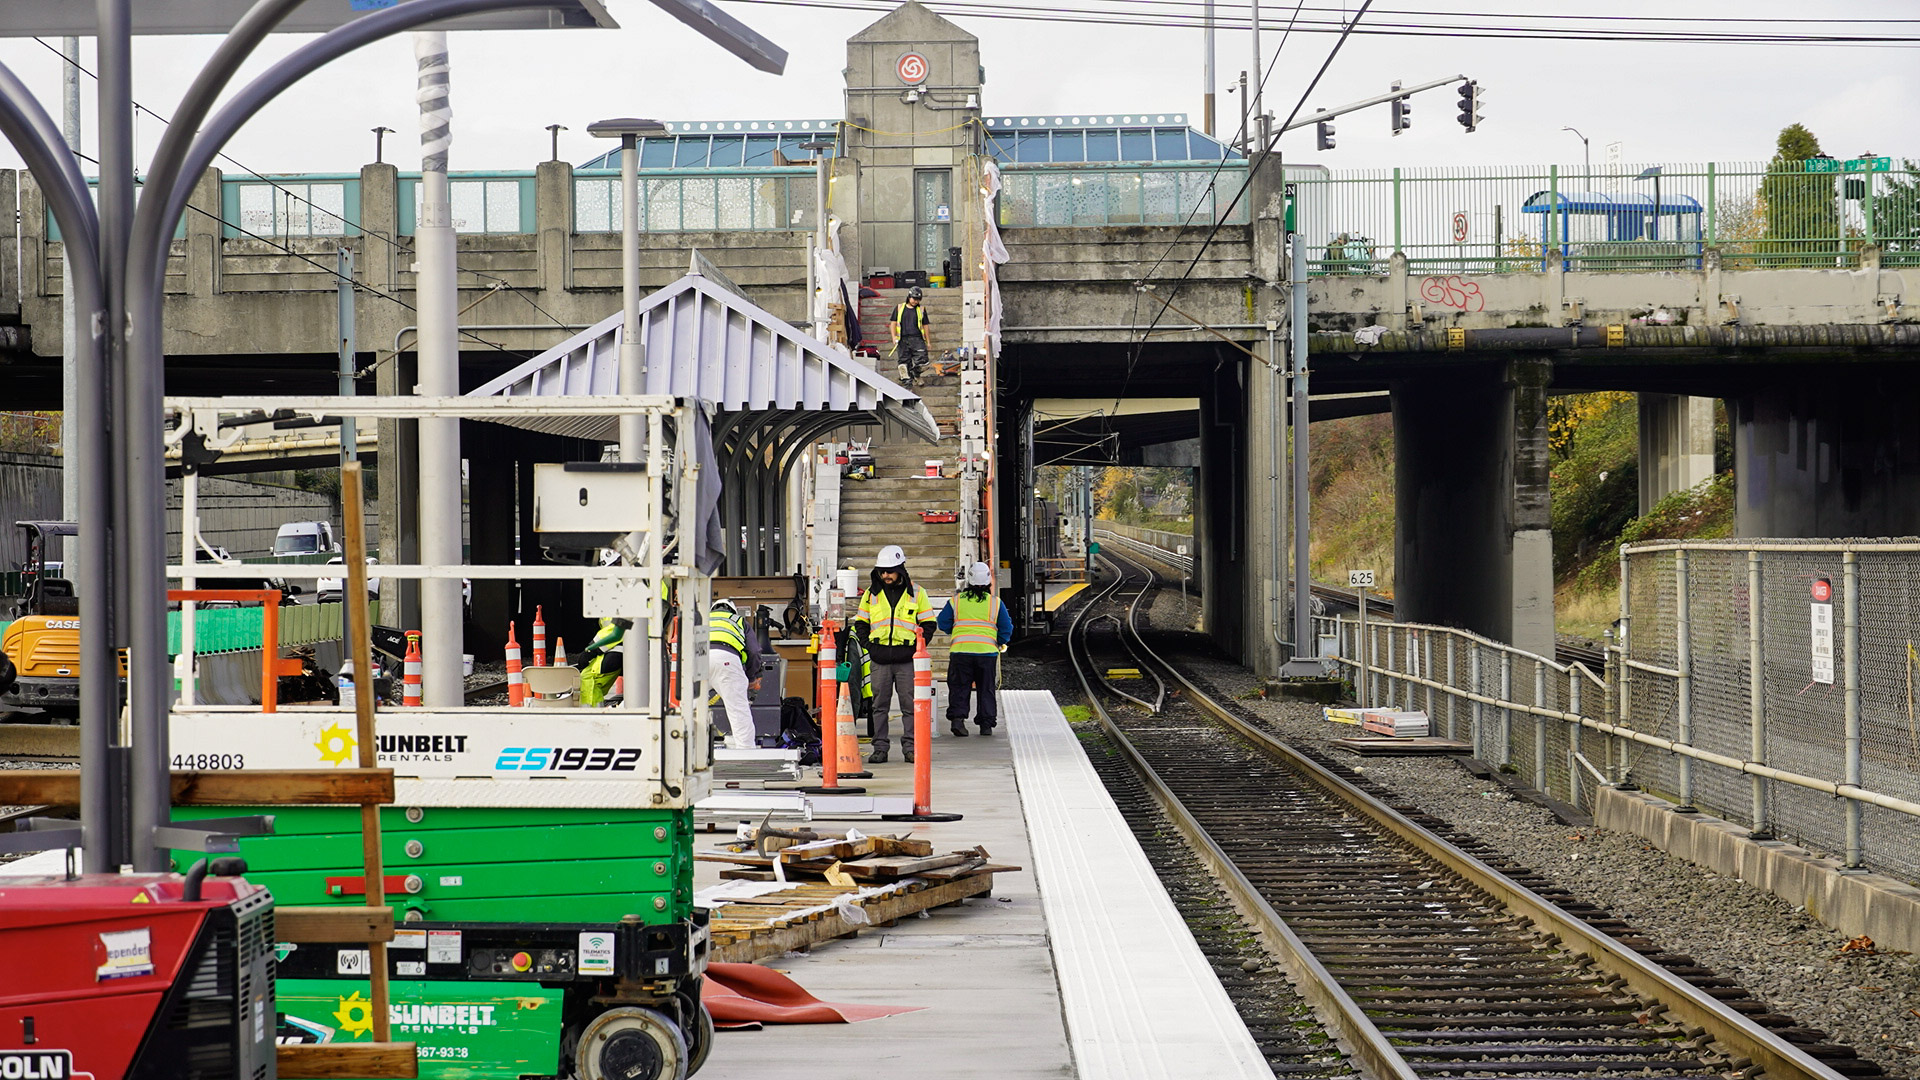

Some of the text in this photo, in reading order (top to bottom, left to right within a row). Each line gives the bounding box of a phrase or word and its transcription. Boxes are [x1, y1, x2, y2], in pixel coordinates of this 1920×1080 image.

[1351, 572, 1373, 584] 6.25
[45, 620, 80, 629] CASE
[169, 753, 244, 770] 448803
[378, 754, 453, 762] RENTALS
[495, 747, 642, 771] ES1932
[389, 1004, 494, 1026] SUNBELT
[0, 1055, 63, 1080] OLN
